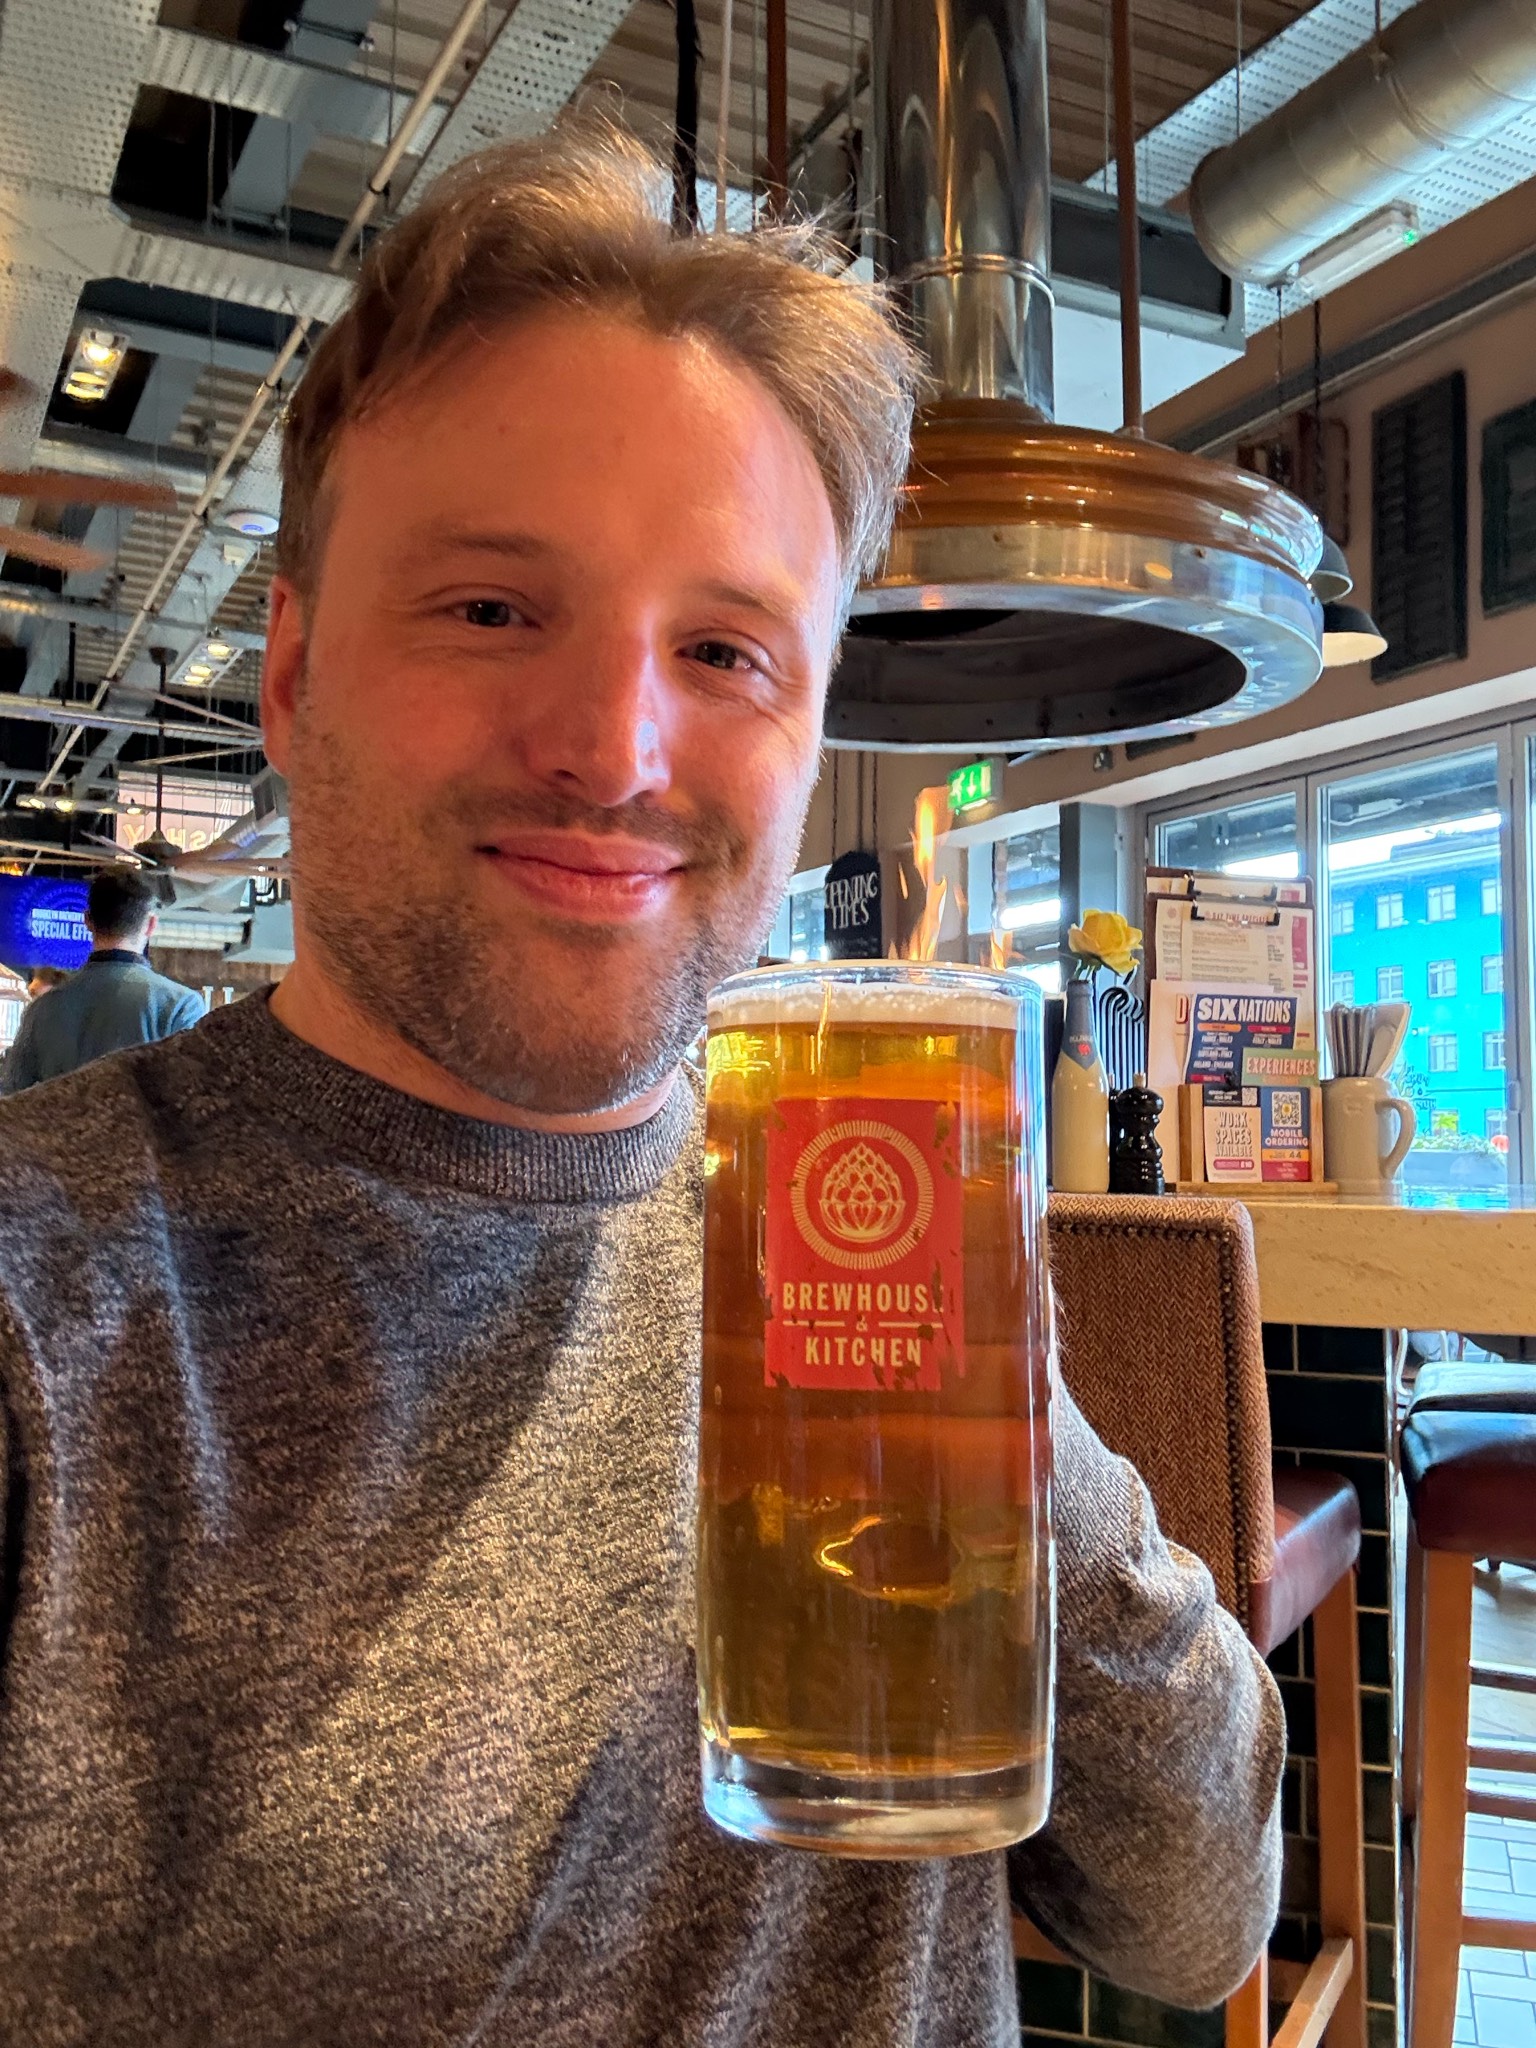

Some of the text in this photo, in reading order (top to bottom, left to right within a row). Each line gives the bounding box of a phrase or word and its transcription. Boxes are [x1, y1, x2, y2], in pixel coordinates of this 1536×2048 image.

[832, 898, 870, 930] TIMES
[31, 920, 71, 940] SPECIAL
[1197, 997, 1291, 1024] SIX NATIONS
[1246, 1056, 1316, 1075] EXPERIENCES
[1219, 1111, 1248, 1129] WORK
[1215, 1128, 1252, 1145] SPACES
[1264, 1137, 1309, 1147] ORDERING
[1270, 1128, 1303, 1138] MOBILE
[1214, 1145, 1253, 1157] AVAILABLE
[805, 1337, 921, 1368] KITCHEN
